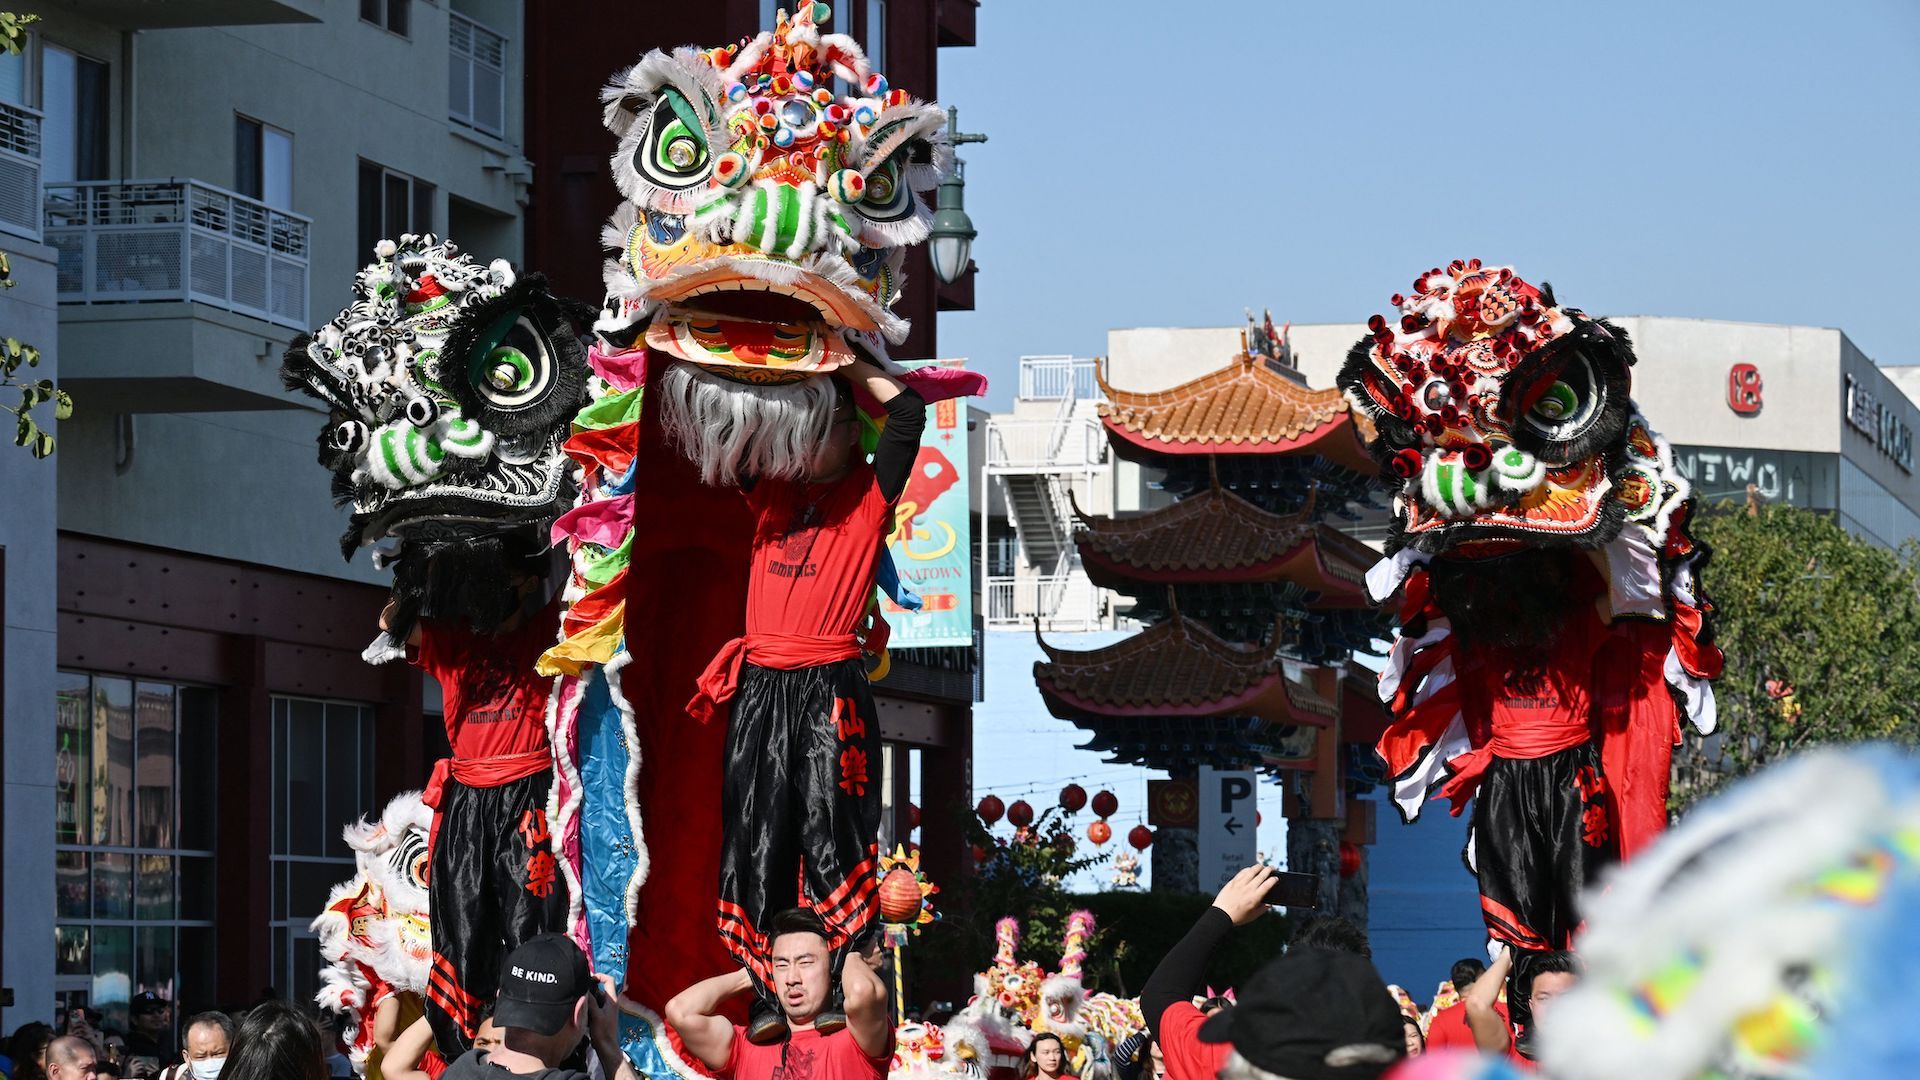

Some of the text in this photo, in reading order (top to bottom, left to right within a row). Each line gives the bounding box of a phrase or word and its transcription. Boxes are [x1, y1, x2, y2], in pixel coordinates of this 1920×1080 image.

[897, 566, 962, 580] INATOWN
[1221, 777, 1252, 813] P
[511, 965, 558, 984] BE KIND.
